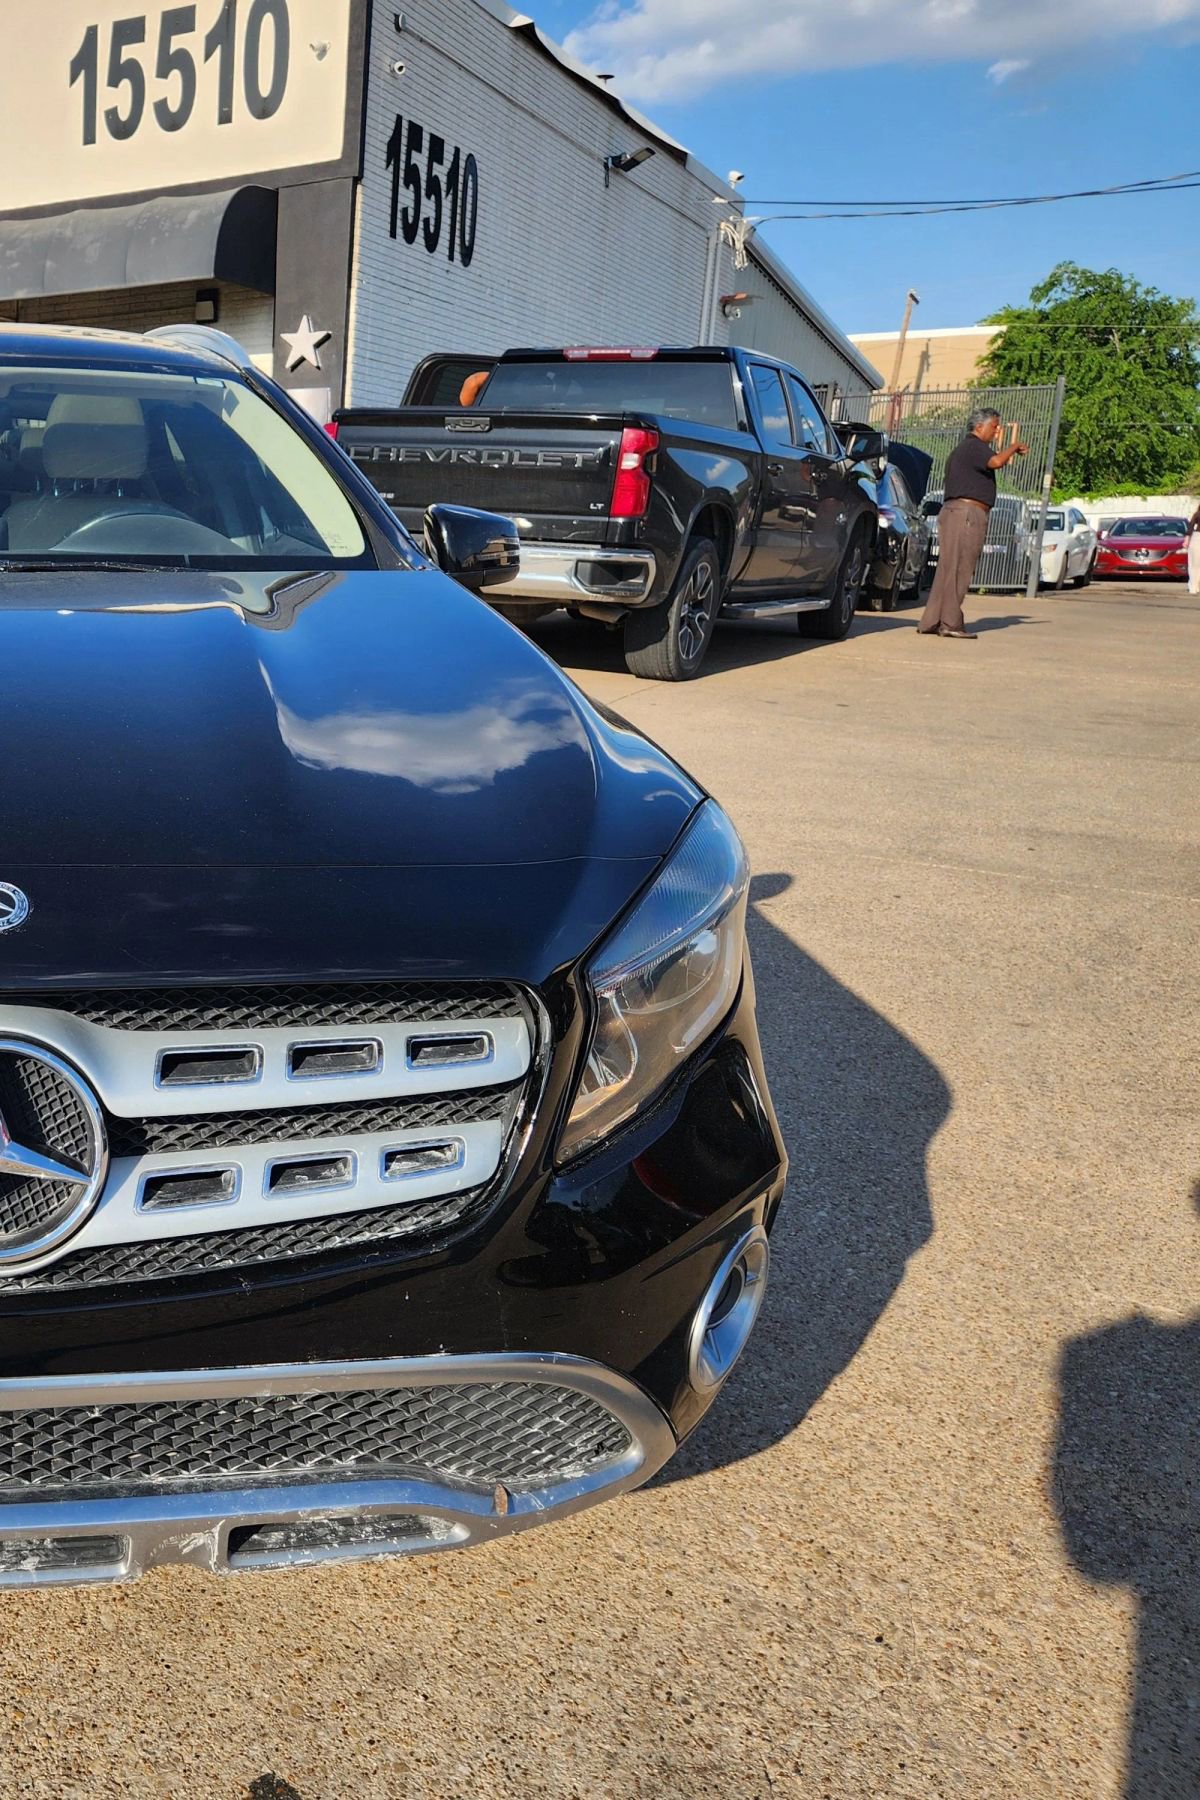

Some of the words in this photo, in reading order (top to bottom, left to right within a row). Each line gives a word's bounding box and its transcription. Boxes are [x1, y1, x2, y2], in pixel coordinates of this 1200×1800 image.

[69, 0, 290, 146] 15510
[385, 113, 479, 268] 15510
[350, 446, 596, 468] CHEVROLET
